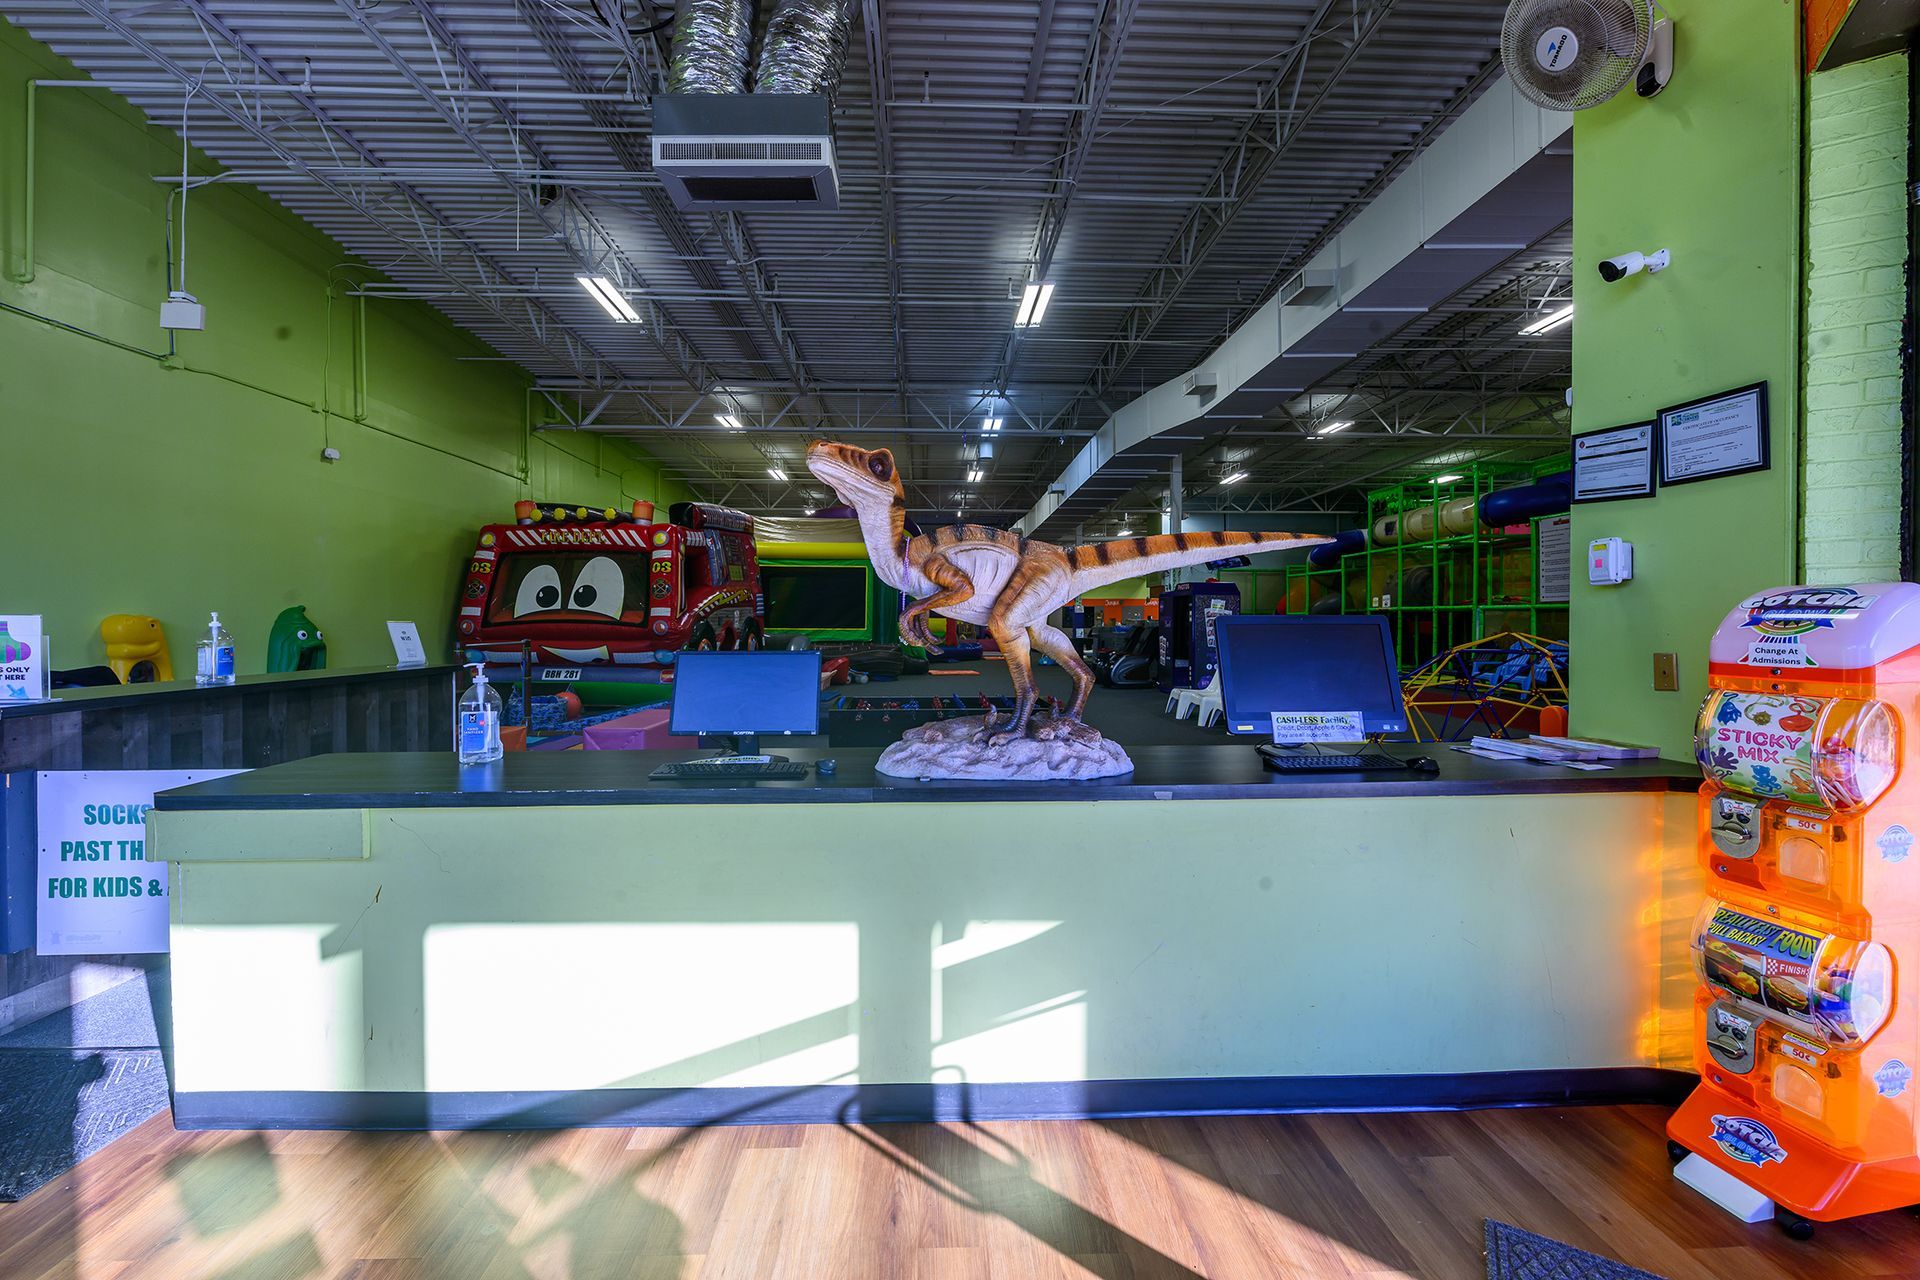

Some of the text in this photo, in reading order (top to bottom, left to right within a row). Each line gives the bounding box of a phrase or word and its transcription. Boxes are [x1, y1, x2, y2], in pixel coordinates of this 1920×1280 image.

[1549, 34, 1568, 68] TORNADO
[470, 561, 491, 573] 03
[652, 560, 672, 573] 03
[1741, 592, 1870, 609] GOTCHA
[1755, 647, 1799, 656] Change At
[1752, 656, 1801, 666] Admissions
[545, 669, 579, 679] BBH 281
[1717, 727, 1803, 751] STICKY
[1736, 746, 1780, 765] MIX
[61, 840, 144, 862] PAST TH
[48, 877, 88, 898] FOR
[93, 876, 143, 898] KIDS
[147, 879, 163, 897] &
[1714, 909, 1757, 931] REALLY
[1708, 922, 1767, 947] PULL BACKS!
[1779, 964, 1806, 976] FINISH
